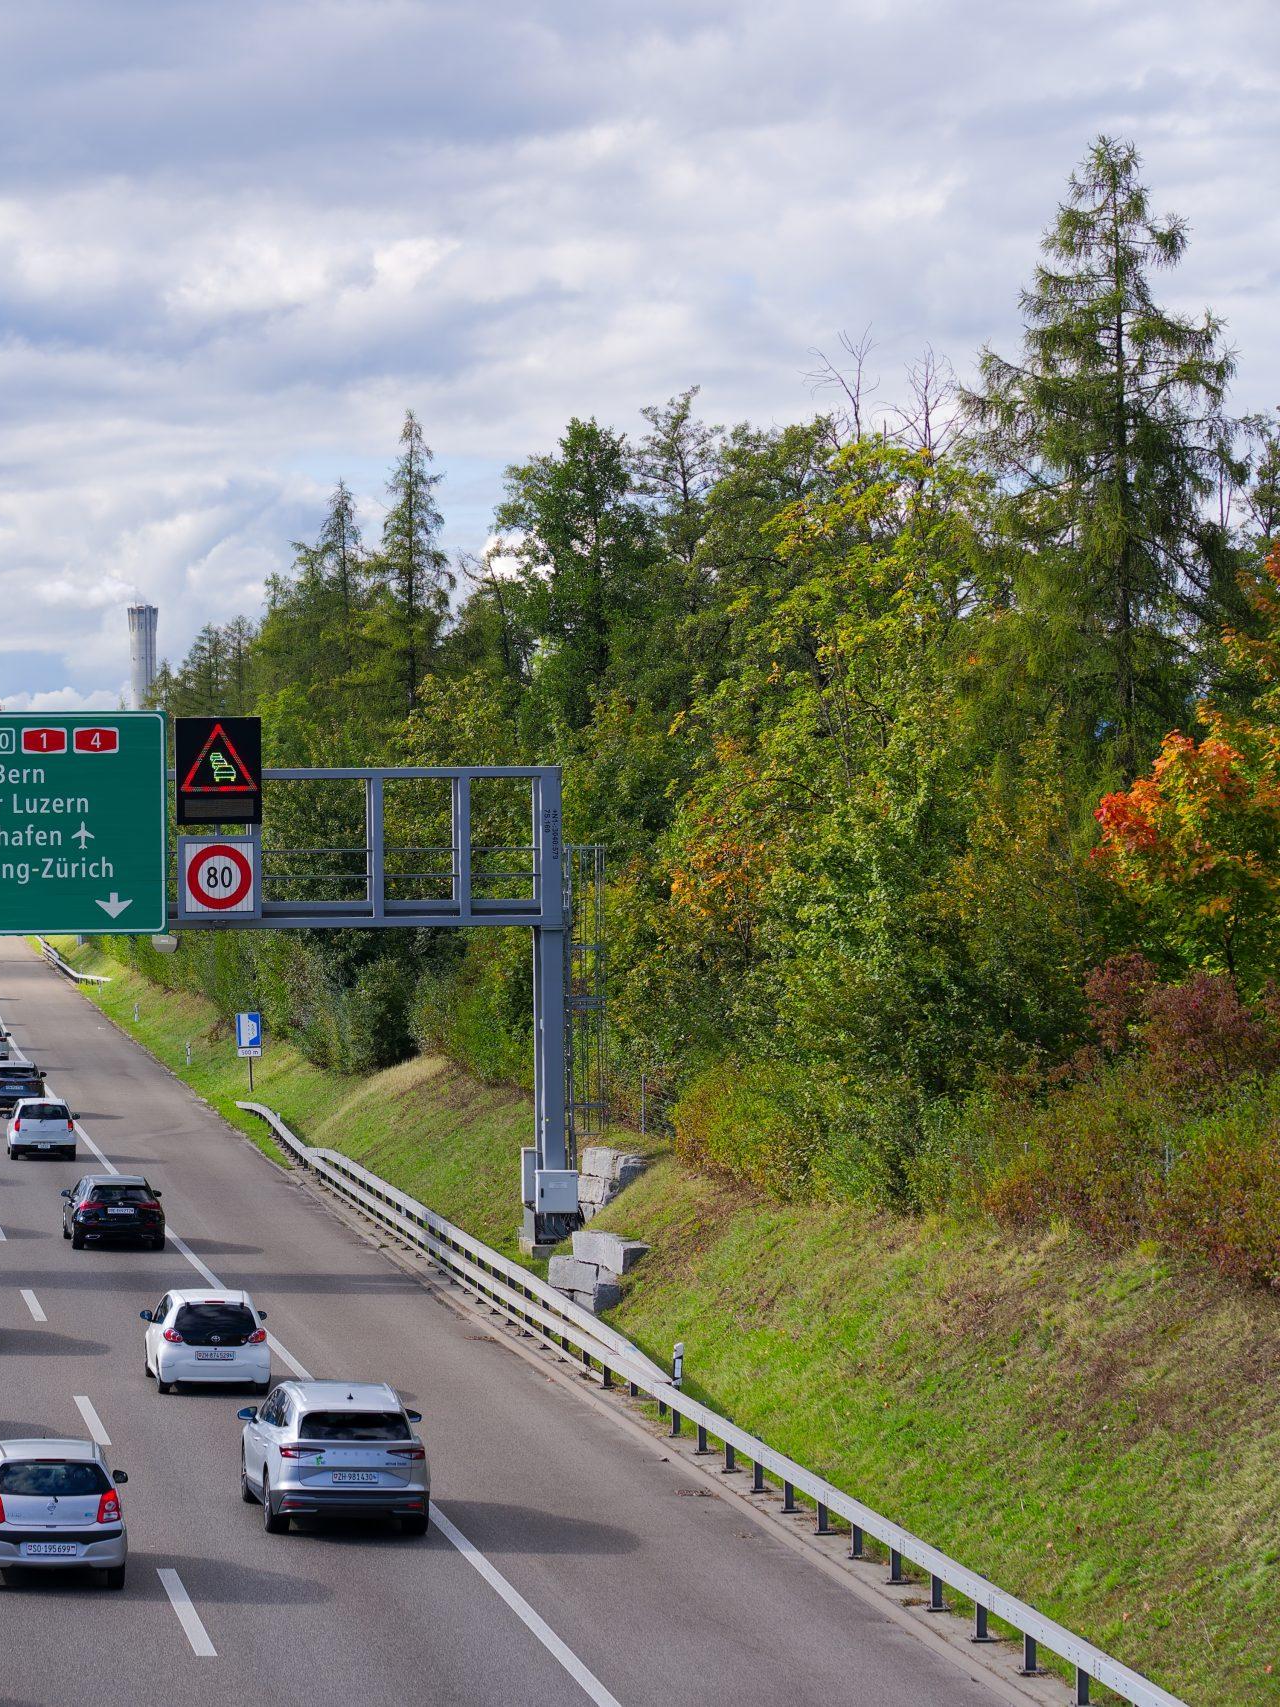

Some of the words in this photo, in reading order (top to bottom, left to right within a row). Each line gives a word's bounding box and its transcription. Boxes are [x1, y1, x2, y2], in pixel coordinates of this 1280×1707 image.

[39, 732, 48, 749] 1
[90, 732, 102, 749] 4
[12, 793, 89, 814] Luzern
[206, 866, 233, 889] 80
